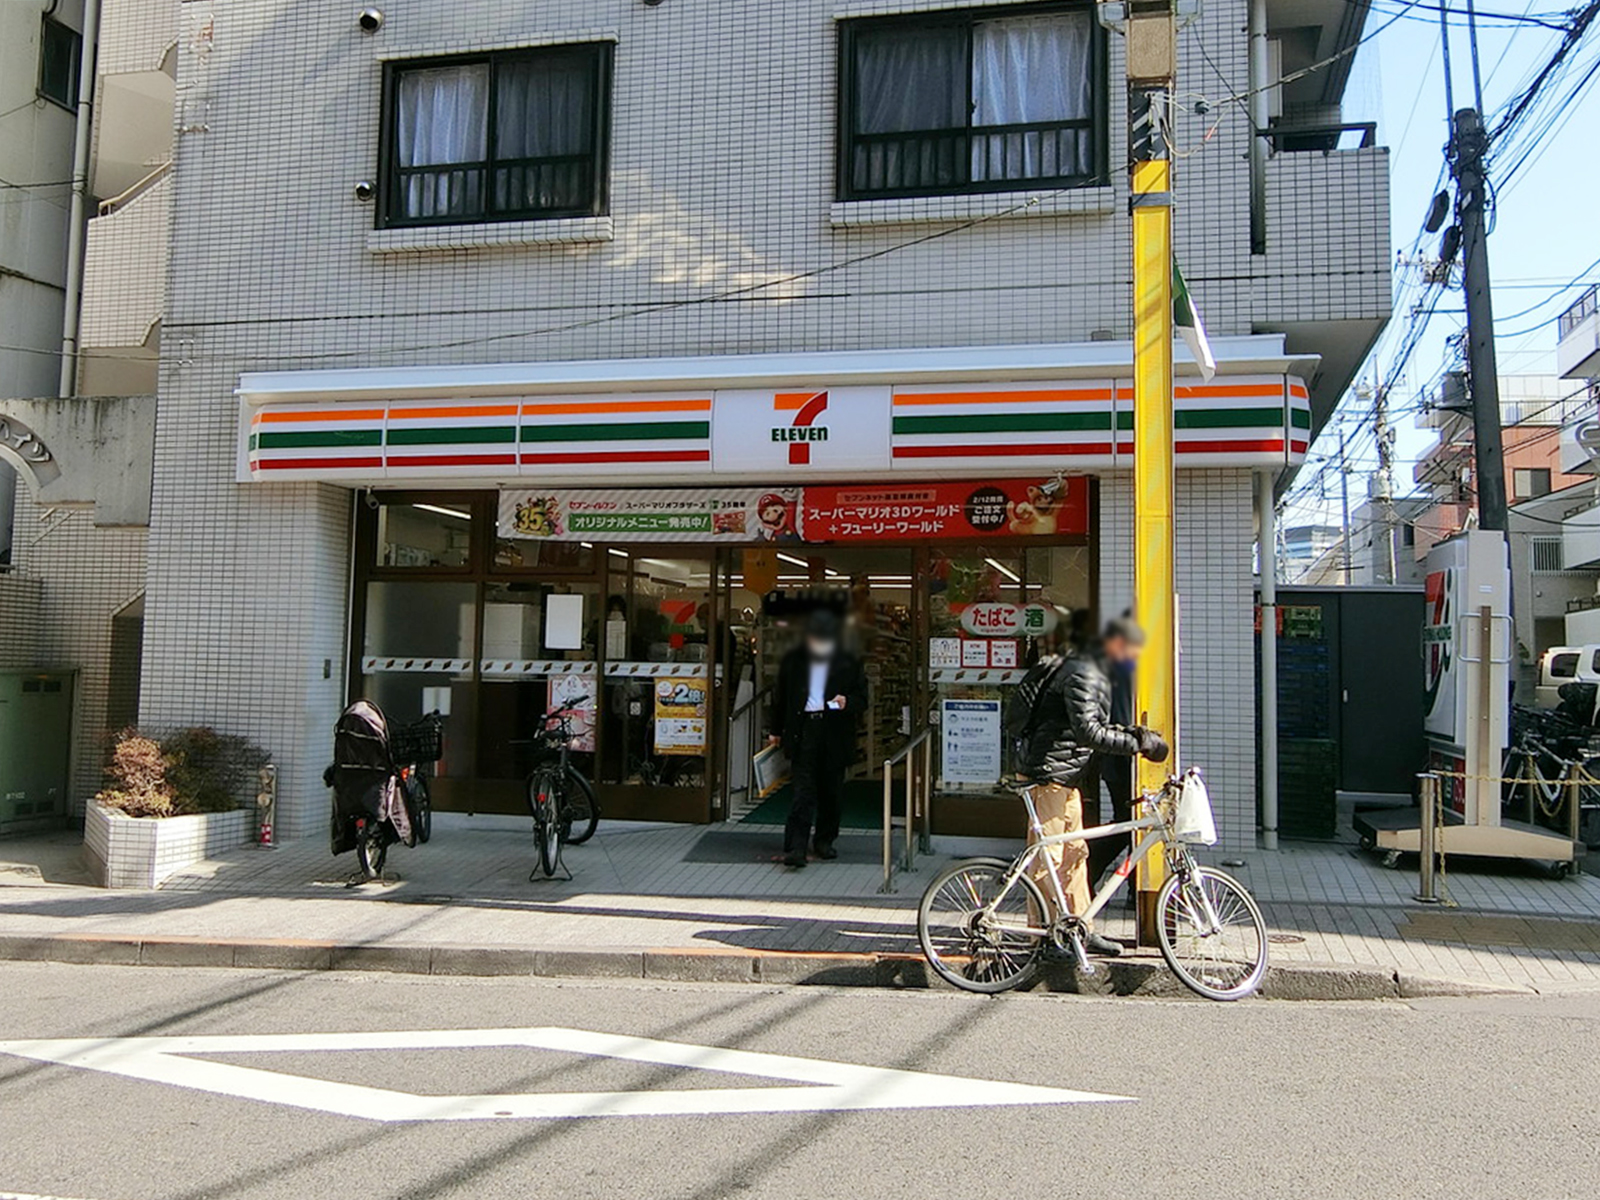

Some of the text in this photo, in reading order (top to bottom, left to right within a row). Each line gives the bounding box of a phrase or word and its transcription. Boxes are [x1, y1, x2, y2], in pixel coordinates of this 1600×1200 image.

[773, 391, 829, 465] 7
[518, 507, 544, 531] 35
[808, 504, 960, 521] スーパーマリオ3Dワールド
[972, 607, 1045, 628] たばこ 酒
